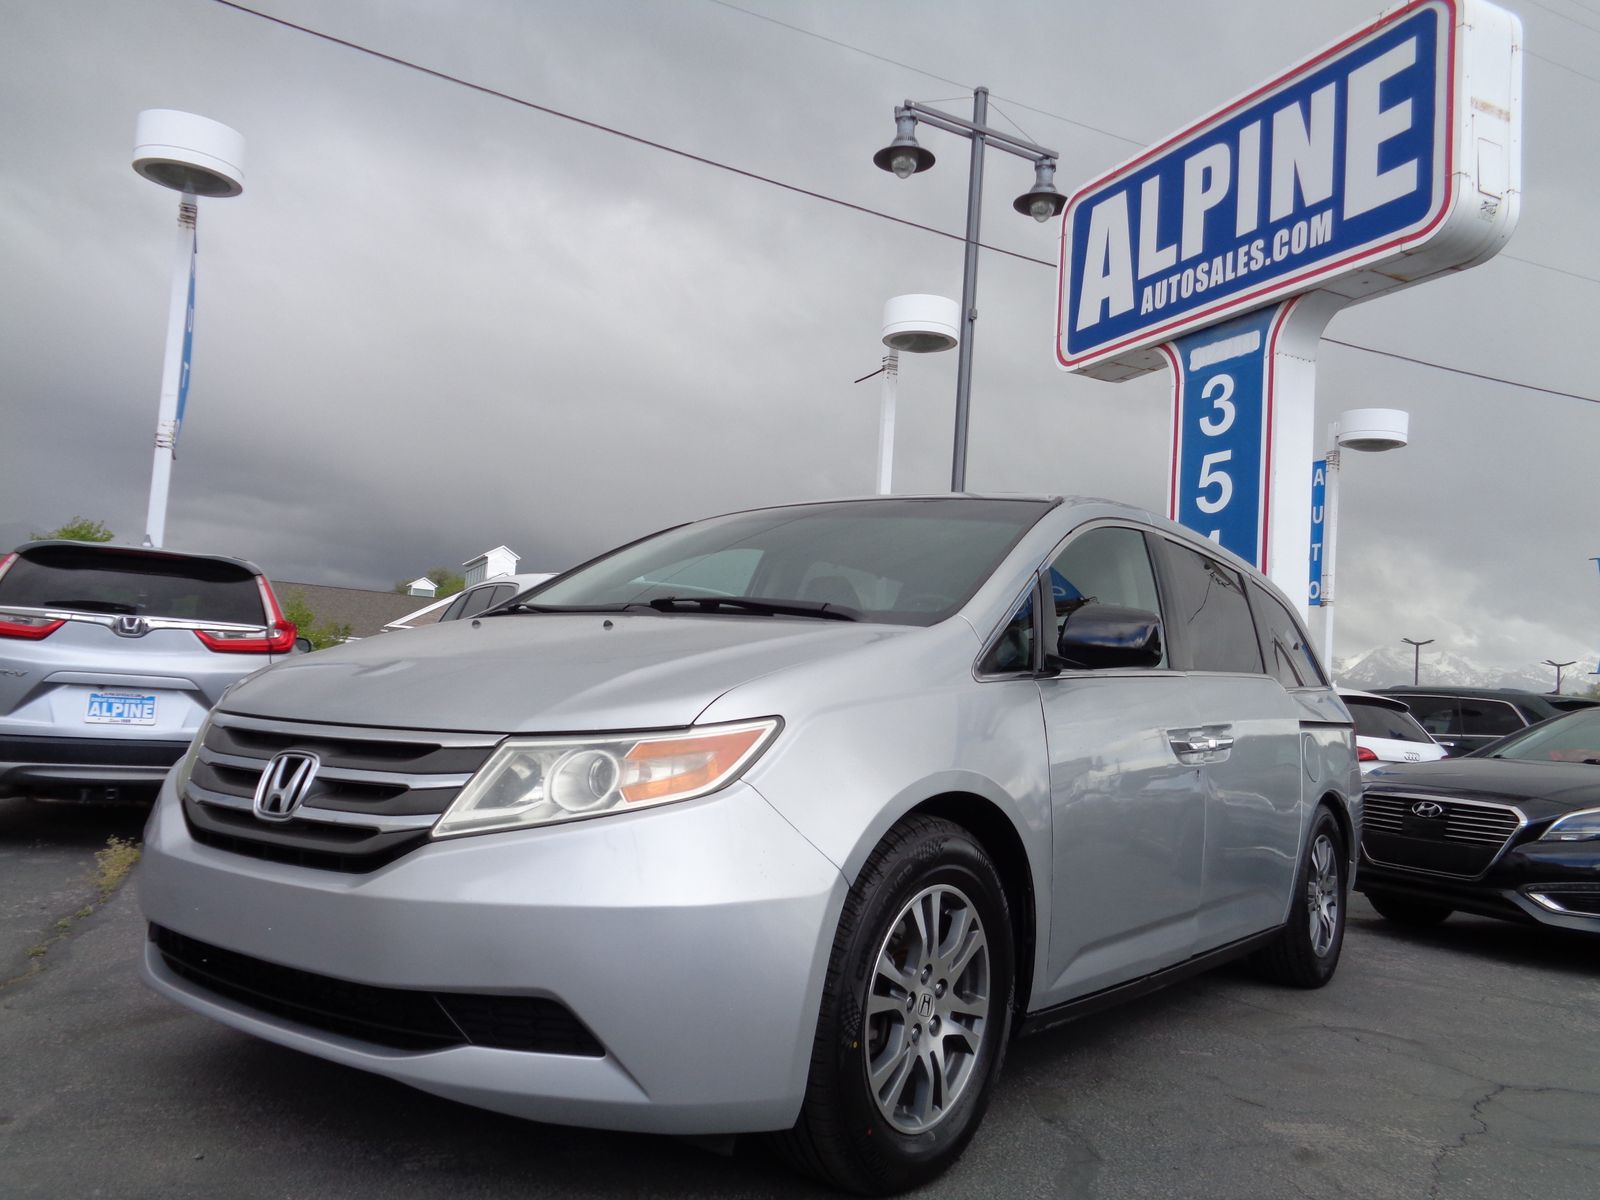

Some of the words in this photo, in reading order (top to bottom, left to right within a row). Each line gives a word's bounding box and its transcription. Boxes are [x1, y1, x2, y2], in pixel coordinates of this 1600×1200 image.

[1076, 35, 1418, 332] ALPINE
[1140, 208, 1333, 316] AUTOSALES.COM
[1309, 467, 1325, 600] AUTO
[88, 701, 154, 719] ALPINE
